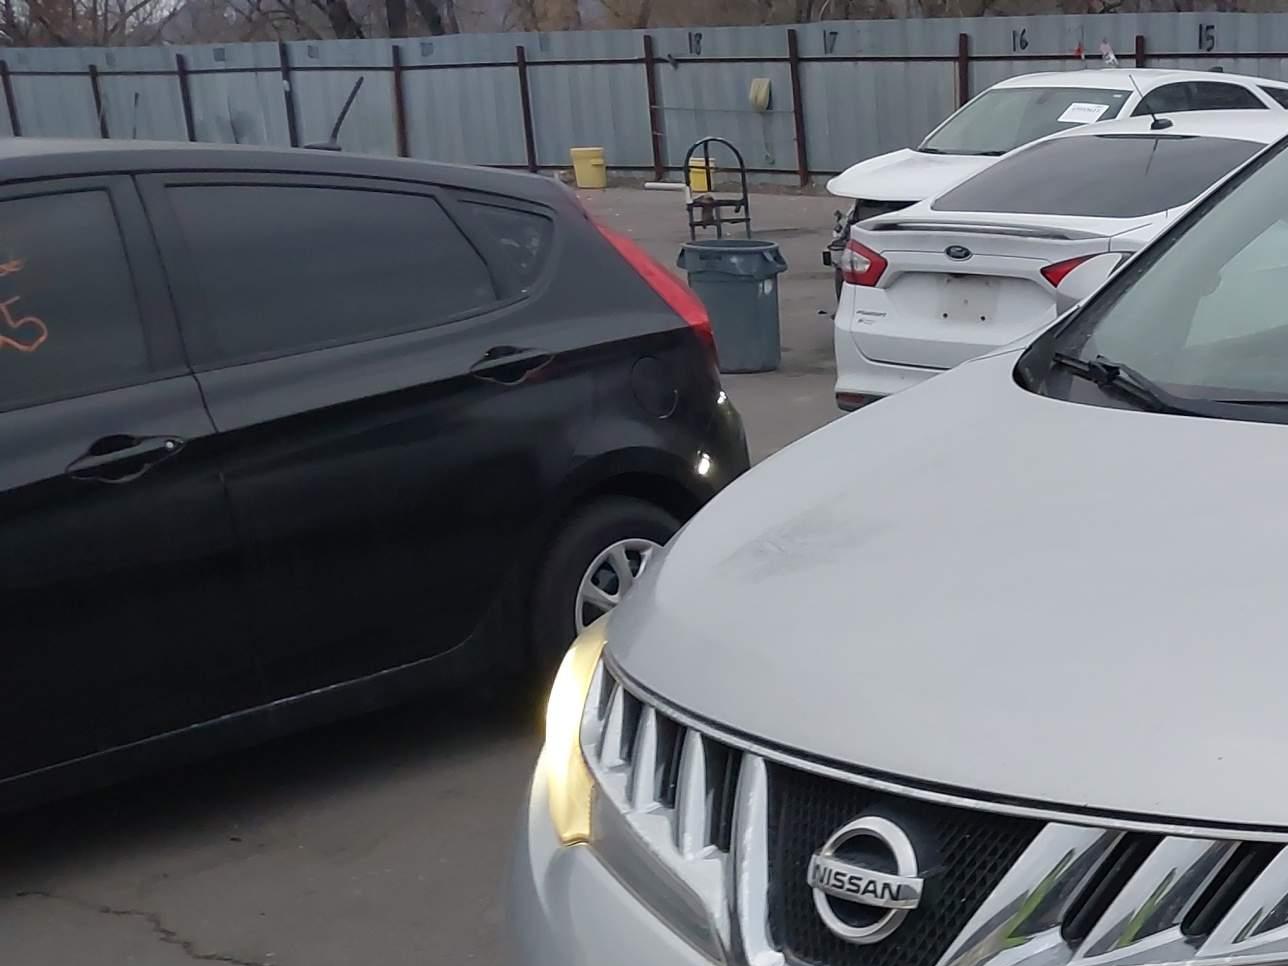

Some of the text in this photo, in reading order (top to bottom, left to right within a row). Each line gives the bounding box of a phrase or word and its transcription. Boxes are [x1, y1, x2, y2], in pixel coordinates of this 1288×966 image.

[688, 31, 703, 56] 18
[823, 29, 838, 55] 17
[1012, 28, 1029, 52] 16
[1198, 23, 1215, 52] 15
[812, 863, 902, 901] NISSAN
